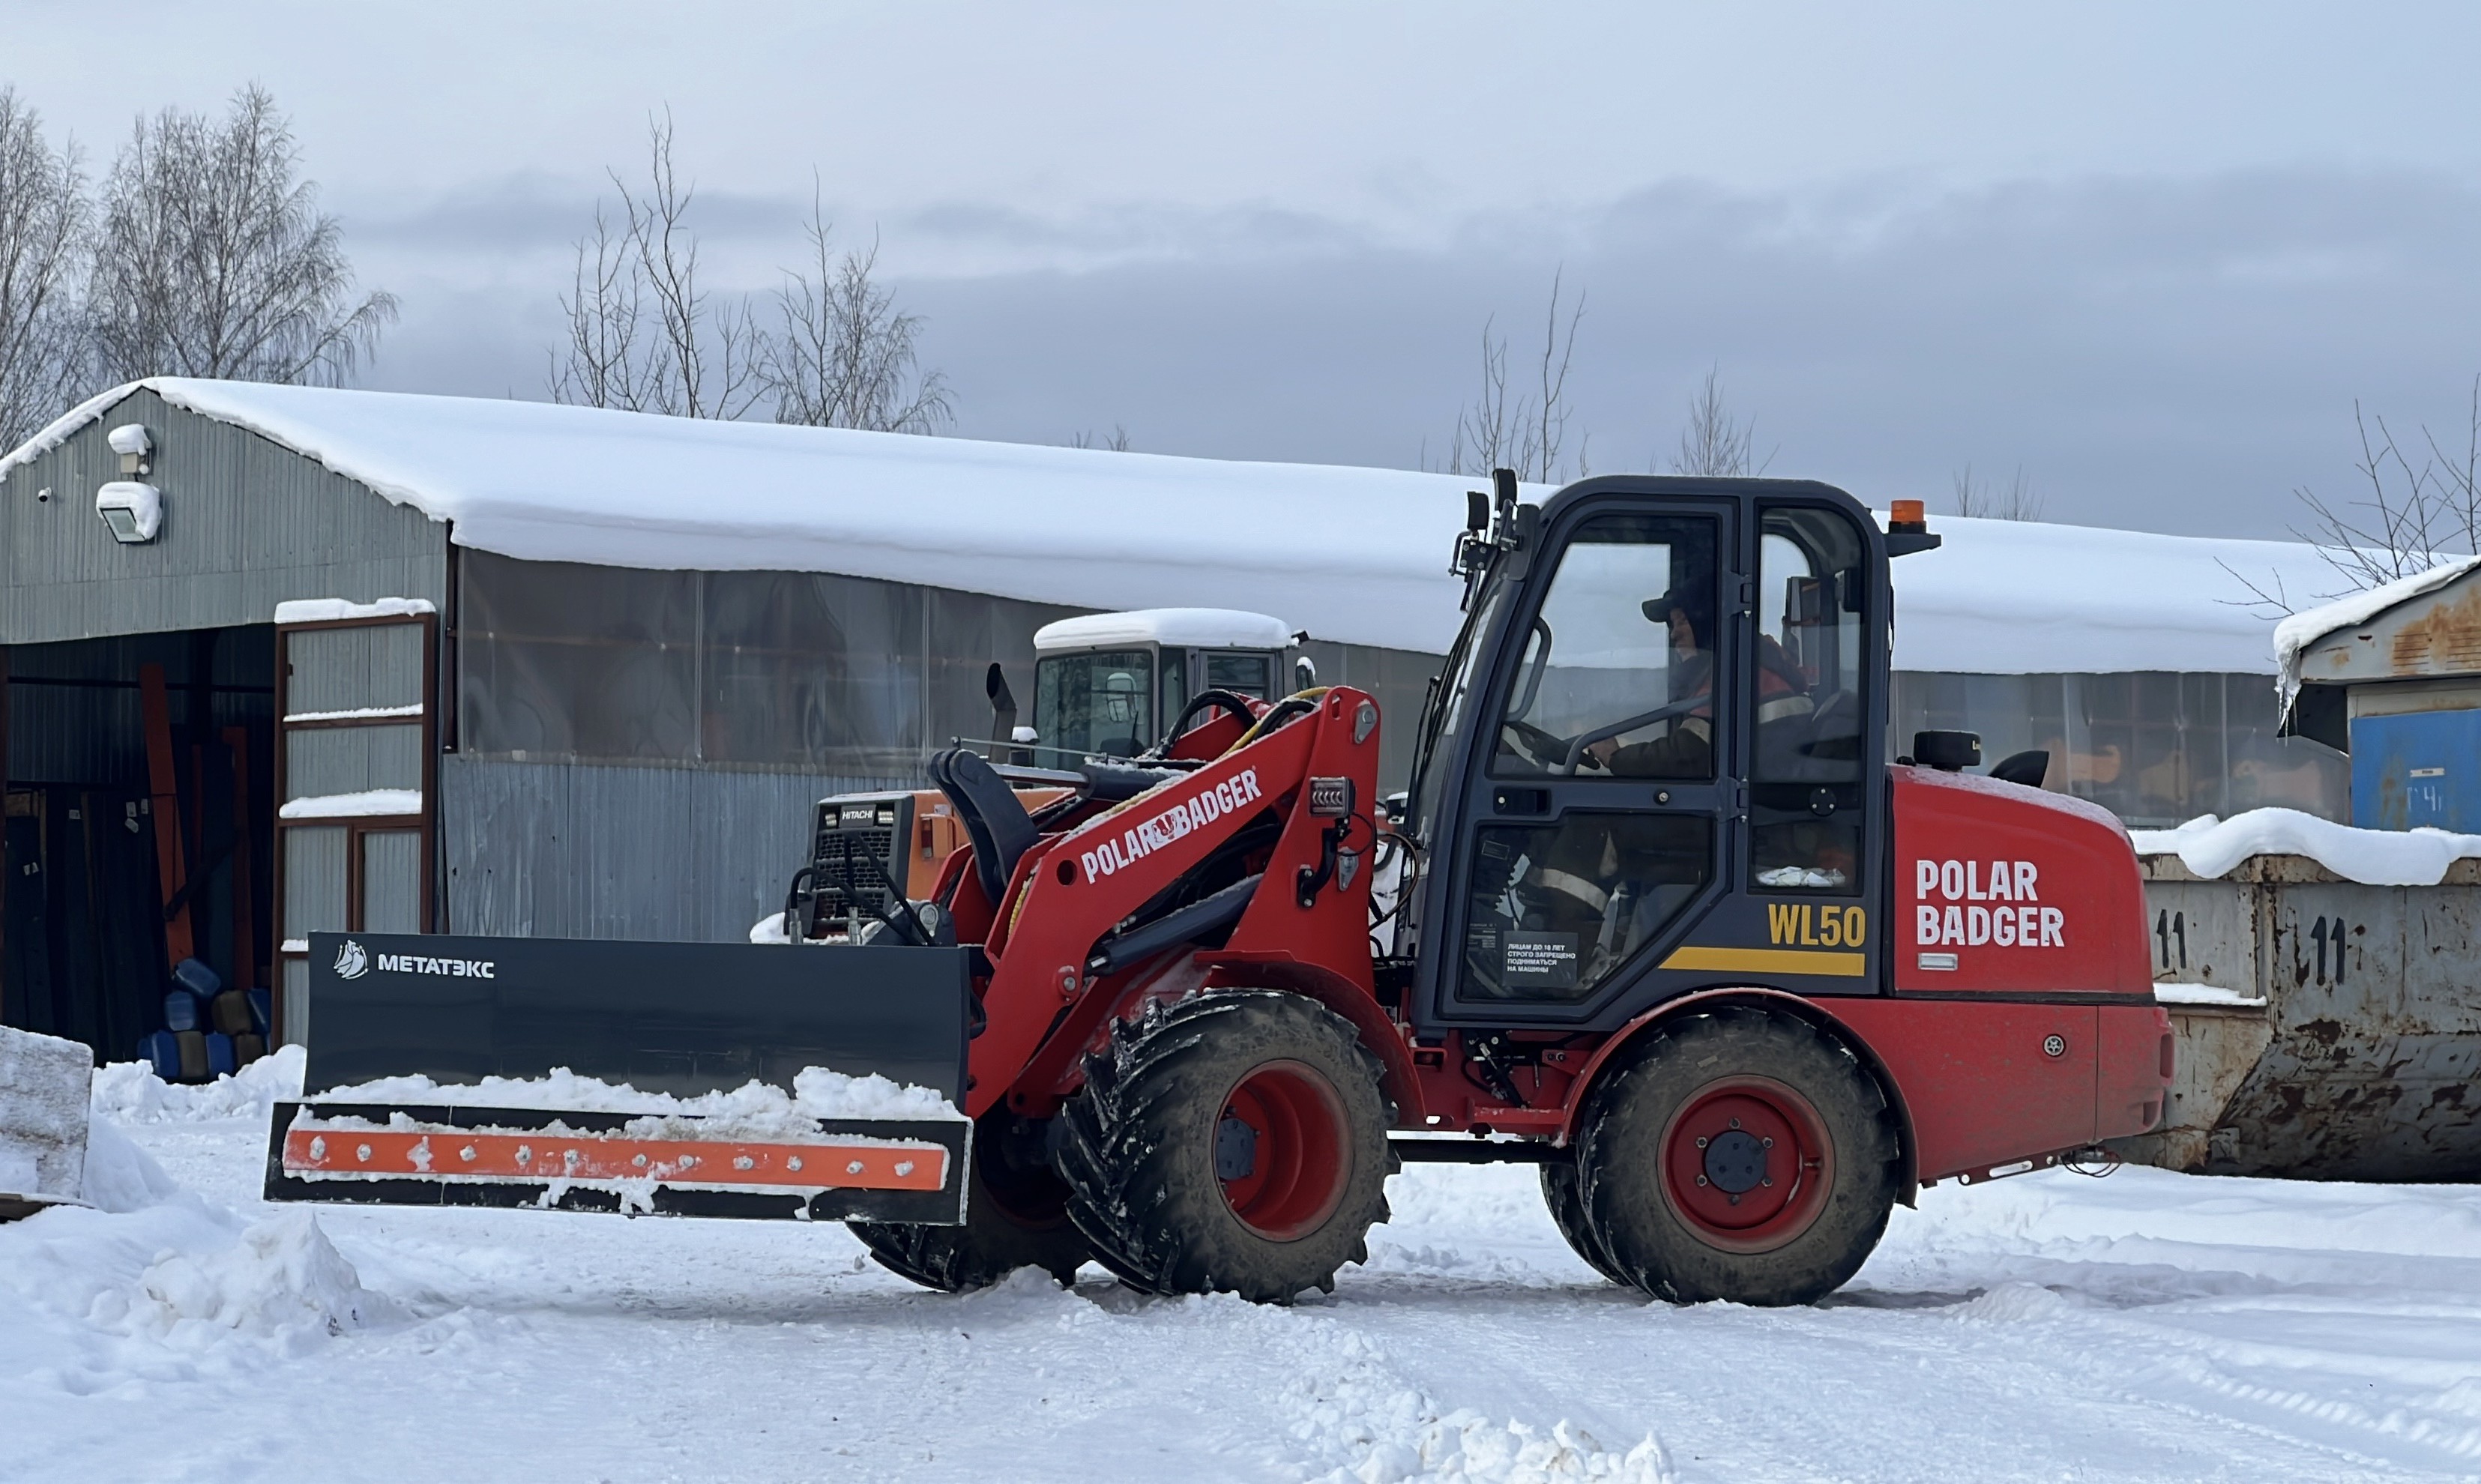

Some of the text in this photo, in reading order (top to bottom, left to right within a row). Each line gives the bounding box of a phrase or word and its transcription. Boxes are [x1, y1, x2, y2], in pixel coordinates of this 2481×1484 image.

[842, 810, 874, 820] HITACHI
[1081, 769, 1261, 884] POLAR BADGER
[1917, 860, 2038, 901] POLAR
[1768, 903, 1866, 947] WL50
[1917, 905, 2064, 947] BADGER
[2156, 909, 2186, 969] 11
[378, 953, 495, 979] МЕТАТЭКС
[2310, 915, 2346, 986] 11
